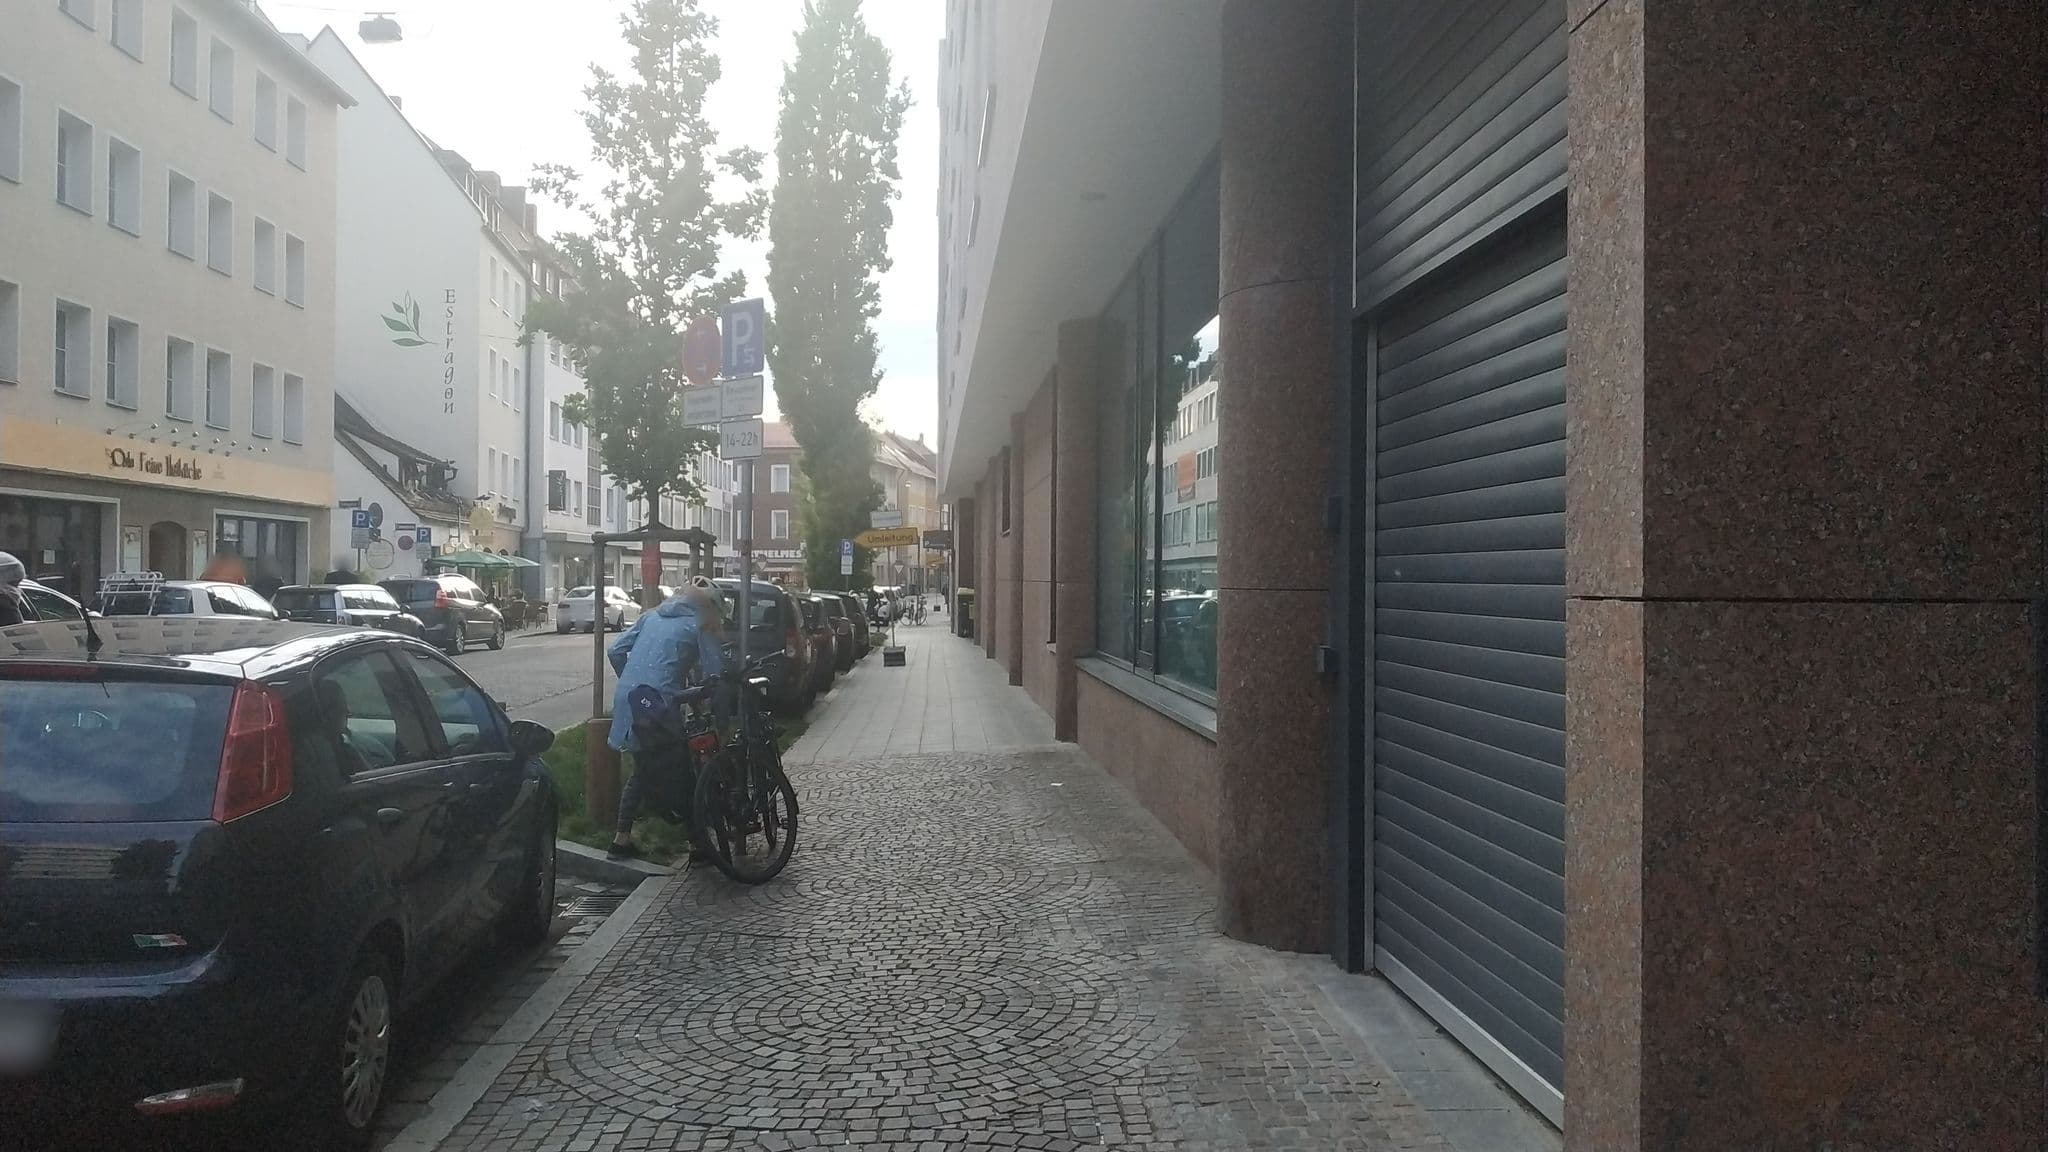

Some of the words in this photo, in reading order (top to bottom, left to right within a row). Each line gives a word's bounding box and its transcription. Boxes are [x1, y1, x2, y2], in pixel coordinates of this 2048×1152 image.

[731, 311, 753, 367] P
[444, 288, 456, 414] Estragon
[355, 512, 366, 526] P
[419, 529, 428, 541] P
[867, 534, 914, 544] Umleitung
